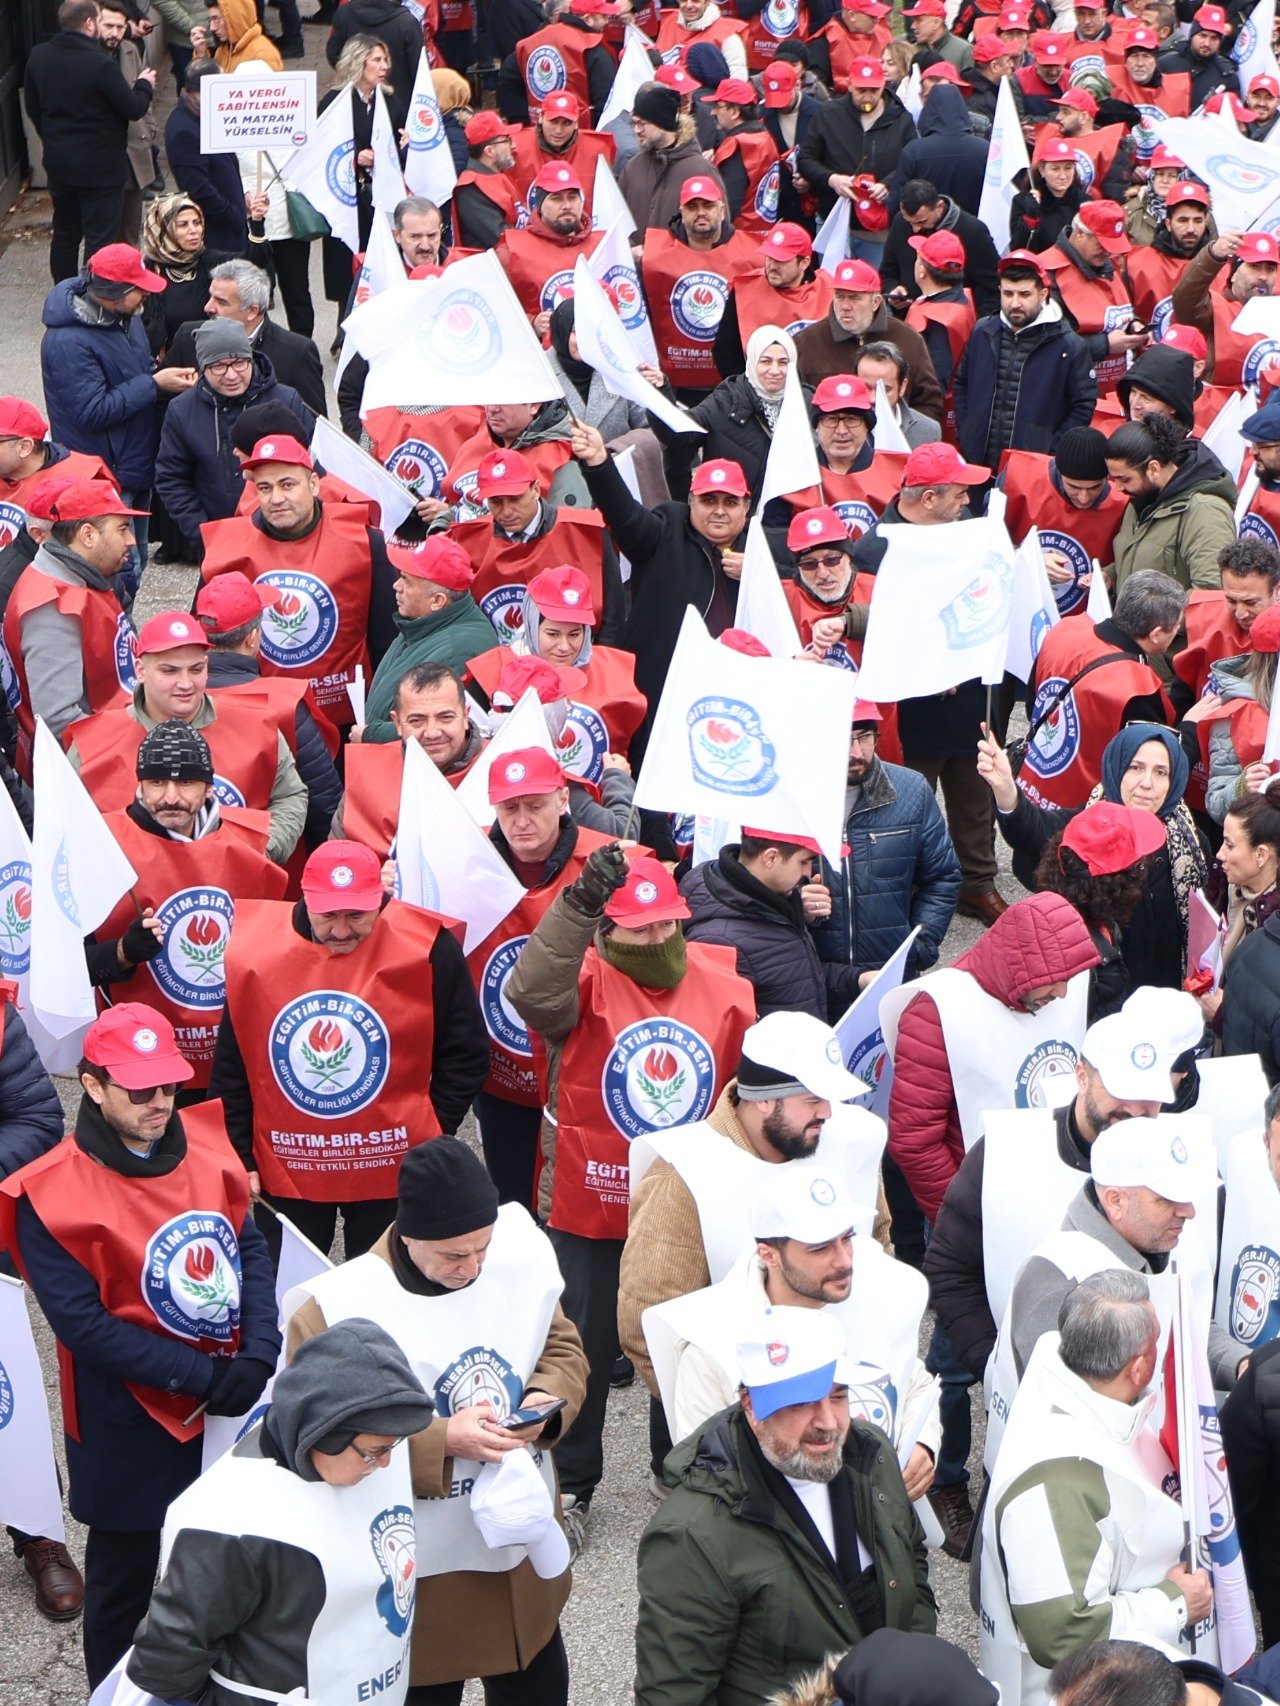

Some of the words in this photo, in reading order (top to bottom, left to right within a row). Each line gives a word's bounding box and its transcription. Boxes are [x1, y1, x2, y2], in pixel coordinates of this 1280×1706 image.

[217, 99, 300, 112] SABİTLENSİN
[228, 89, 244, 99] YA
[249, 86, 287, 98] VERGİ
[222, 116, 239, 125] YA
[242, 113, 295, 125] MATRAH
[224, 124, 293, 137] YÜKSELSİN
[155, 958, 199, 1000] EĞİTİMCİLER
[275, 999, 381, 1046] EĞİTİM-BİR-SEN
[612, 1025, 712, 1075] EĞİTİM-BİR-SEN
[1020, 1049, 1046, 1085] ENERJİ
[278, 1059, 316, 1107] EĞİTİMCİLER
[317, 1095, 352, 1109] BİRLİĞİ
[352, 1056, 381, 1101] SENDİKASI
[270, 1125, 408, 1149] EĞİTİM-BİR-SEN
[273, 1145, 319, 1157] EĞİTİMCİLER
[322, 1147, 356, 1158] BİRLİĞİ
[358, 1141, 409, 1155] SENDİKASI
[286, 1160, 314, 1171] GENEL
[316, 1162, 351, 1172] YETKİLİ
[353, 1158, 396, 1170] SENDİKA
[150, 1220, 237, 1290] EĞİTİM-BİR-SEN
[439, 1353, 473, 1396] ENERJİ
